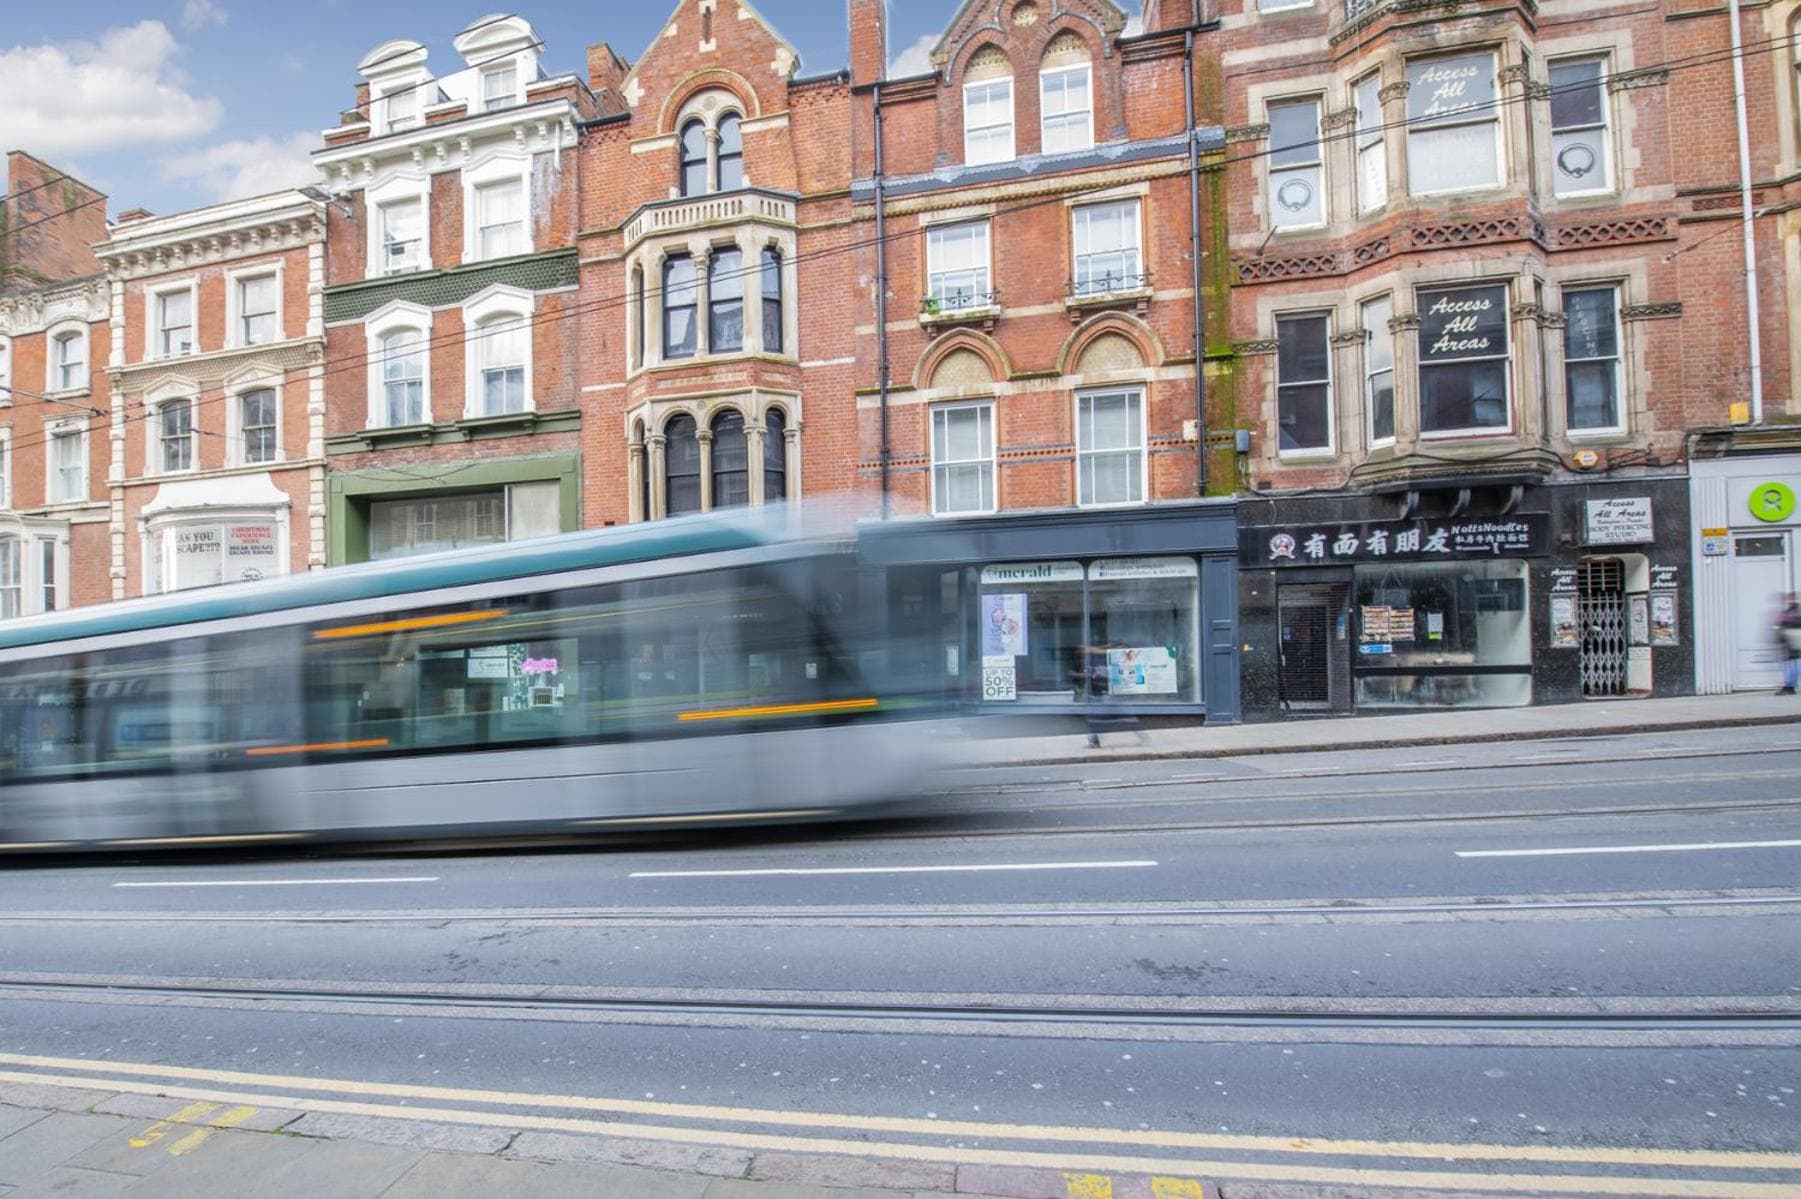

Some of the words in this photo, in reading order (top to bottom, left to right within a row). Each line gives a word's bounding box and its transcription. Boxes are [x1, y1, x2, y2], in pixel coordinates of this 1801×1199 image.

[1416, 66, 1480, 85] Access
[1430, 80, 1467, 101] All
[1428, 296, 1494, 316] Access
[1441, 315, 1478, 335] All
[1429, 334, 1491, 354] Areas
[1602, 499, 1635, 508] Access
[1594, 509, 1612, 518] All
[1616, 508, 1647, 517] Areas
[193, 531, 213, 541] YOU
[1303, 526, 1452, 559] 有面有朋友
[1550, 568, 1578, 577] Access
[1651, 564, 1678, 572] Access
[1557, 576, 1573, 584] All
[1656, 572, 1672, 580] All
[985, 676, 1014, 687] 50%
[985, 686, 1014, 697] OFF
